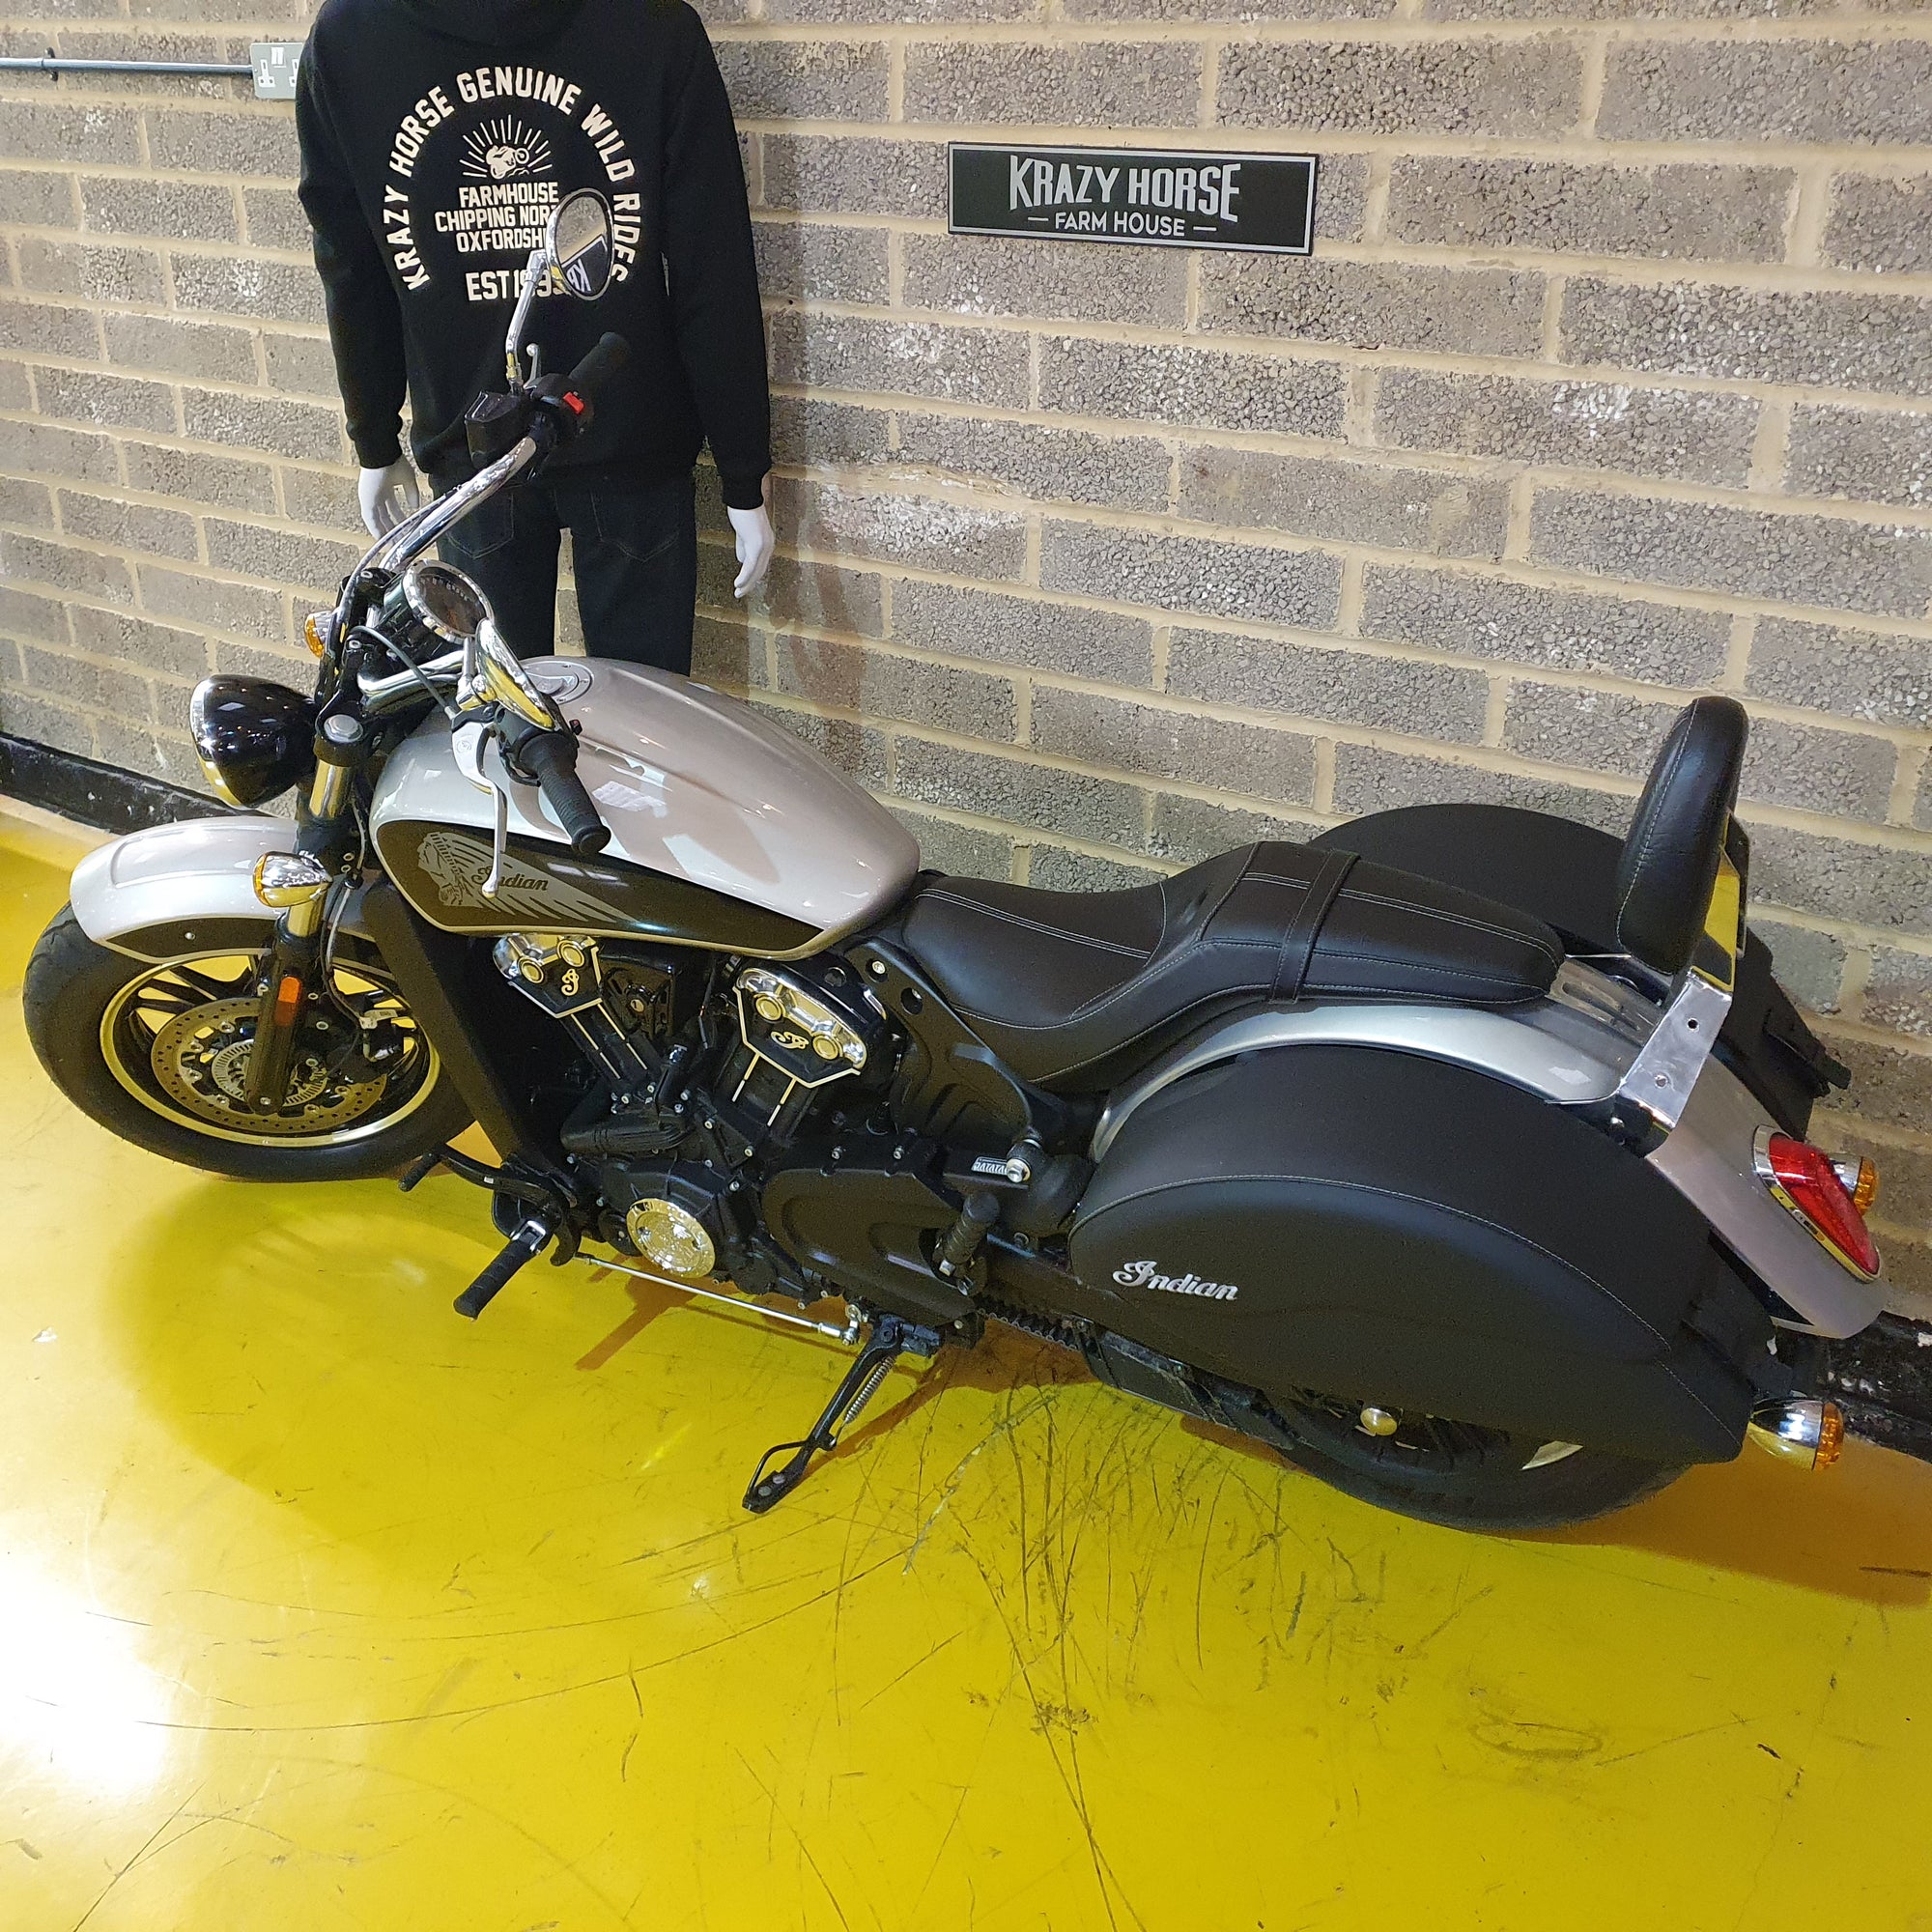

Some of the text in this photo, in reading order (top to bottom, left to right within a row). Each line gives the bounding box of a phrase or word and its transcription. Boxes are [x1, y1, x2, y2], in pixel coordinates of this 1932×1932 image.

[456, 66, 582, 115] GENUINE
[389, 86, 455, 178] HORSE
[581, 103, 636, 183] WILD
[458, 182, 559, 209] FARMHOUSE
[1009, 155, 1241, 223] KRAZY HORSE
[384, 185, 431, 291] KRAZY
[435, 205, 555, 233] CHIPPING NOR
[1055, 211, 1185, 237] FARM HOUSE
[456, 227, 547, 253] OXFORDSHI
[466, 270, 510, 301] EST
[1113, 1261, 1238, 1300] Indian
